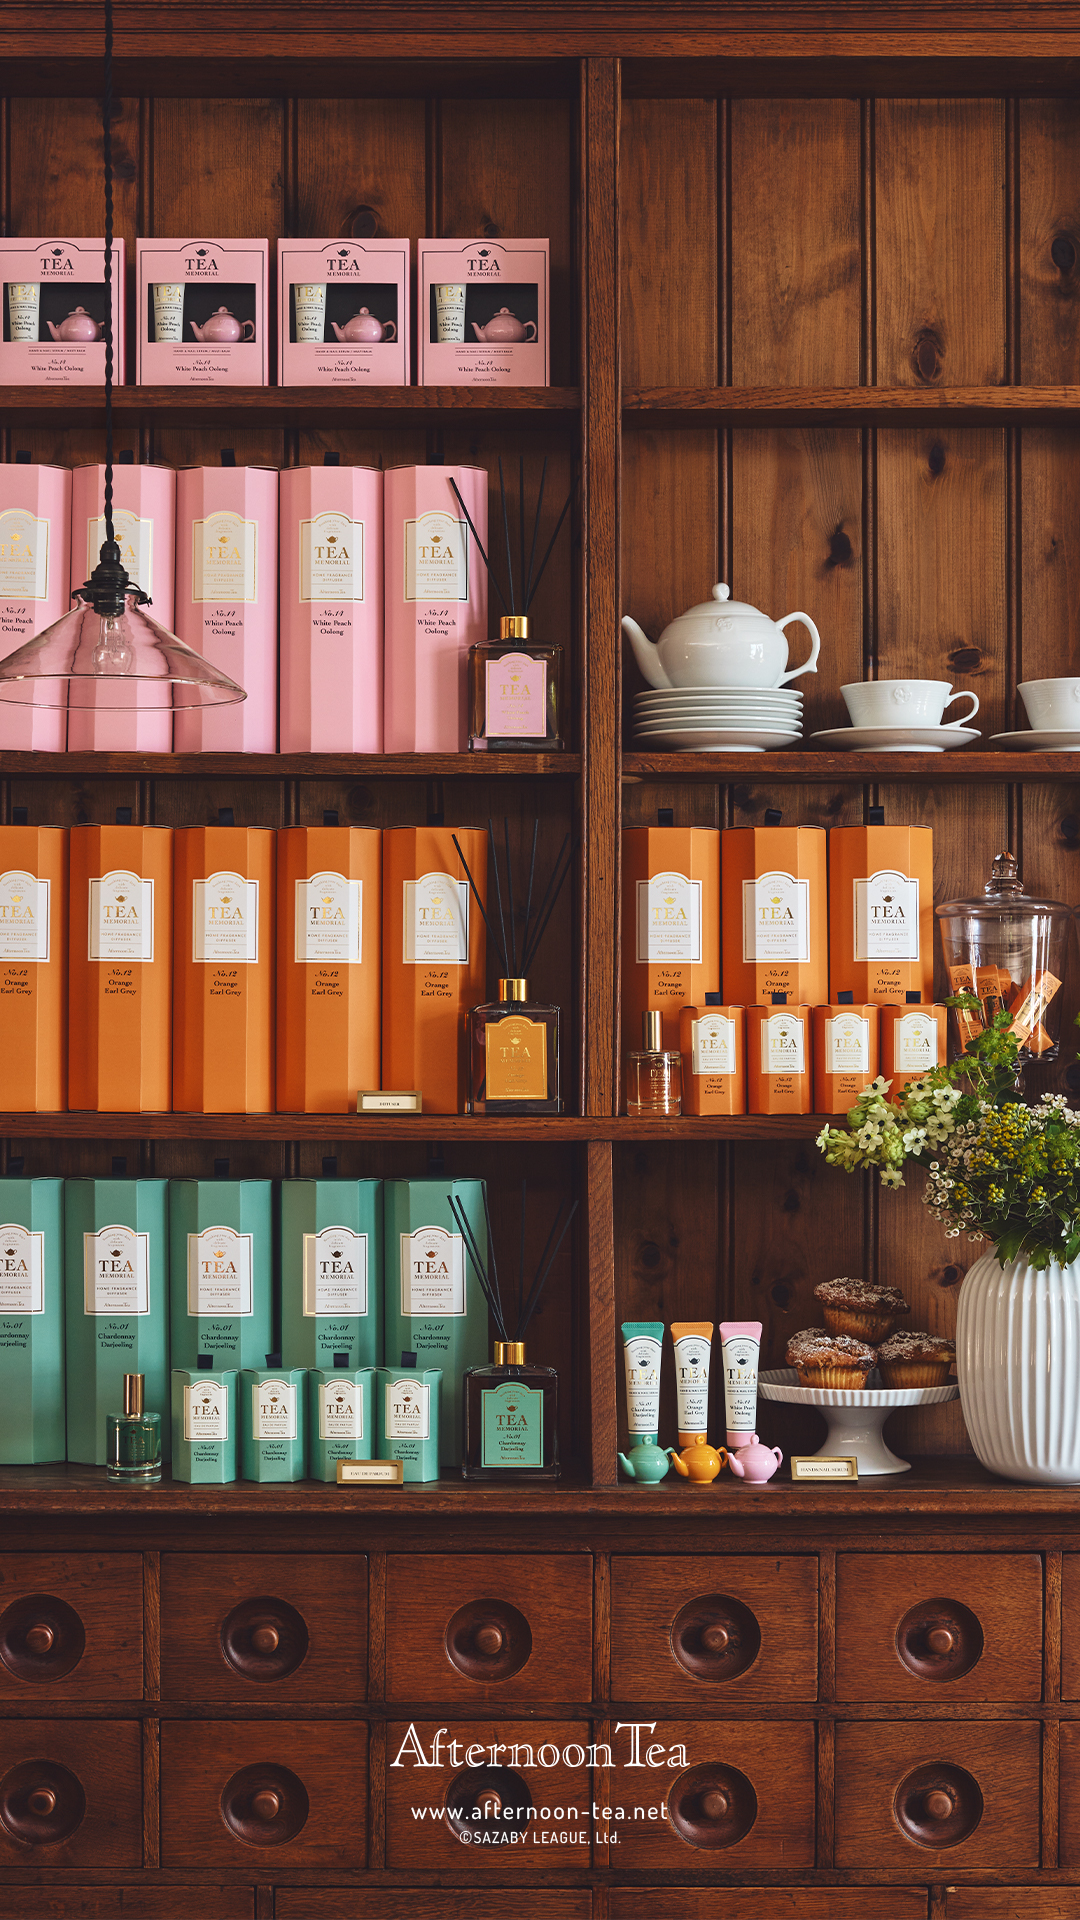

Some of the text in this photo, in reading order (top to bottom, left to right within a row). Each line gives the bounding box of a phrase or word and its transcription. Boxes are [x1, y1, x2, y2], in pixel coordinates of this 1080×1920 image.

[40, 258, 74, 270] TEA
[185, 259, 219, 270] TEA
[327, 259, 360, 271] TEA
[467, 259, 501, 271] TEA
[10, 286, 36, 297] TEA
[155, 286, 181, 297] TEA
[296, 286, 323, 297] TEA
[436, 286, 464, 297] TEA
[0, 544, 33, 556] TEA
[206, 546, 241, 559] TEA
[314, 546, 350, 559] TEA
[419, 546, 454, 558] TEA
[500, 684, 531, 695] TEA
[0, 906, 34, 918] TEA
[103, 906, 138, 918] TEA
[208, 907, 243, 919] TEA
[310, 907, 345, 919] TEA
[419, 907, 454, 920] TEA
[652, 907, 688, 919] TEA
[759, 907, 794, 919] TEA
[871, 906, 905, 918] TEA
[437, 990, 453, 998] Grey
[701, 1039, 728, 1049] TEA
[771, 1038, 797, 1048] TEA
[834, 1038, 861, 1047] TEA
[904, 1038, 930, 1047] TEA
[500, 1047, 531, 1058] TEA
[99, 1260, 134, 1272] TEA
[202, 1261, 237, 1273] TEA
[320, 1261, 354, 1273] TEA
[414, 1261, 449, 1273] TEA
[628, 1369, 658, 1380] TEA
[679, 1368, 707, 1378] TEA
[727, 1369, 756, 1379] TEA
[193, 1406, 219, 1415] TEA
[261, 1405, 288, 1414] TEA
[327, 1404, 353, 1414] TEA
[394, 1404, 420, 1414] TEA
[496, 1415, 528, 1426] TEA
